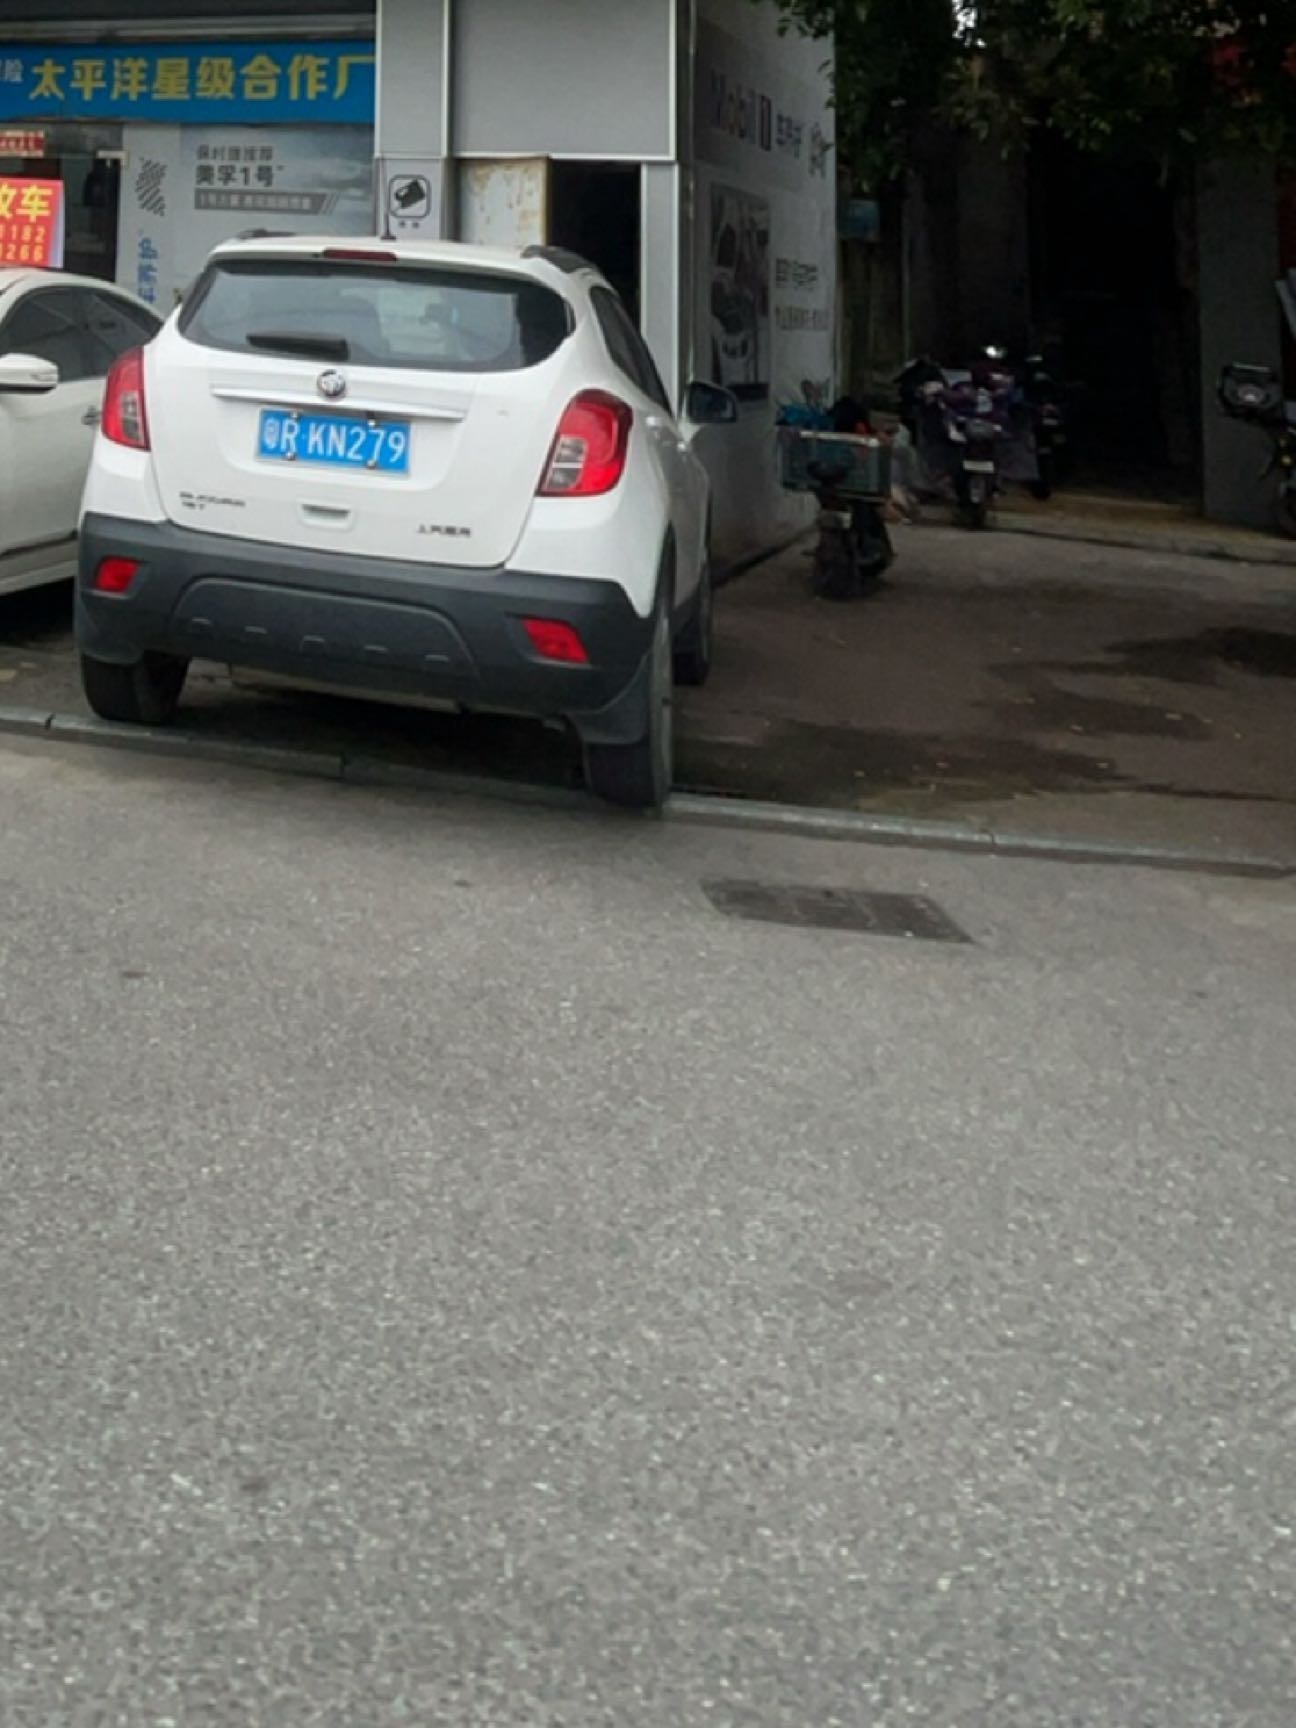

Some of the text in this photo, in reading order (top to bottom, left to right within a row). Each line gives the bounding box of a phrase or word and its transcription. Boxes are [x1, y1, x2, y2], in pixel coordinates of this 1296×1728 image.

[28, 54, 375, 102] 太平洋星级合作厂
